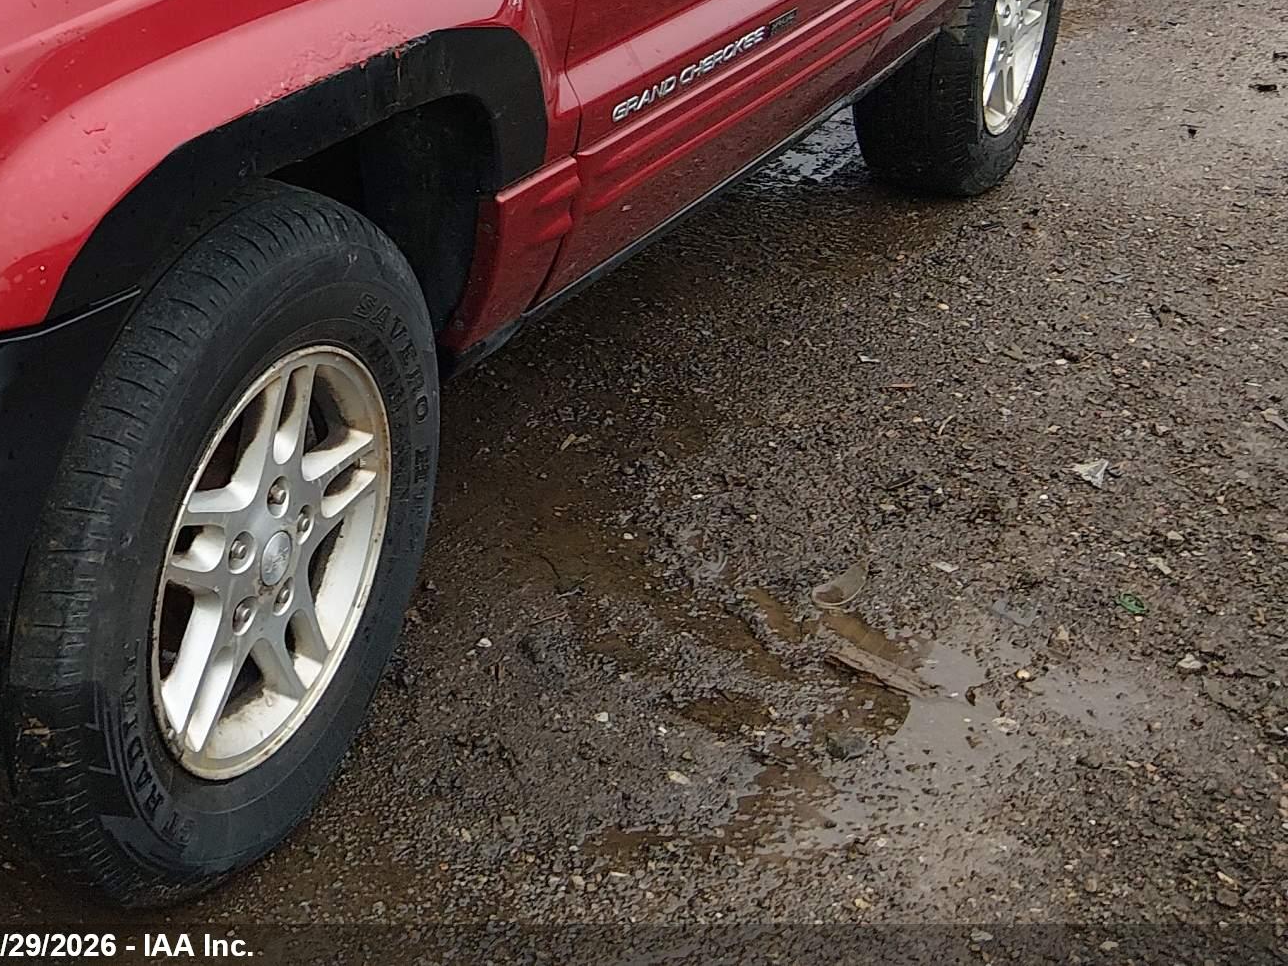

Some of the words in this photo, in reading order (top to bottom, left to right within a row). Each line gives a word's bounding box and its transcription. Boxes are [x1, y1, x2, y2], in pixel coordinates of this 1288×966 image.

[612, 75, 677, 123] GRAND
[679, 26, 768, 85] CHEROKEE
[352, 291, 429, 424] SAVERO
